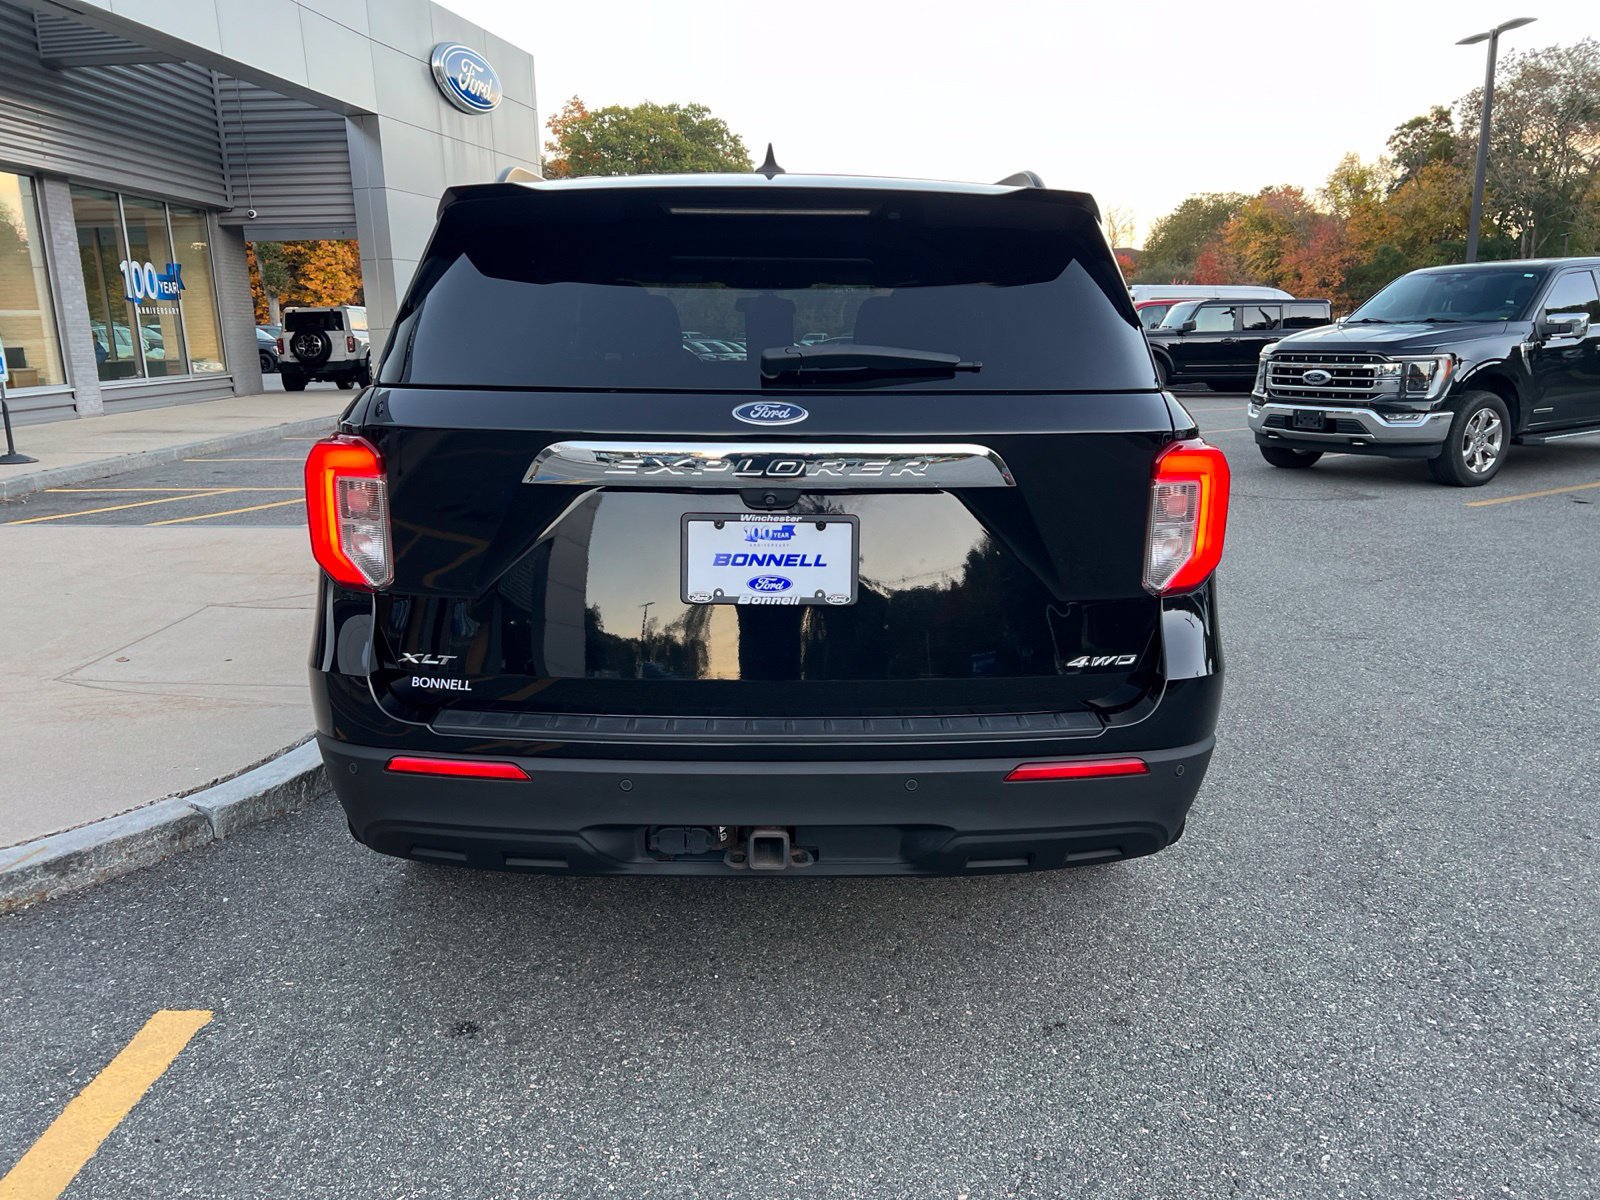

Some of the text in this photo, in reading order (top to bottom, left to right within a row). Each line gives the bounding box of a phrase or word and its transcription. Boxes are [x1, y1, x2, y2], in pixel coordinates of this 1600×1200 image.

[458, 58, 493, 101] Ford
[119, 260, 159, 300] 100
[137, 306, 179, 315] ANNIVERSARY
[749, 404, 791, 419] Ford
[603, 457, 930, 476] EXPLORER
[740, 514, 802, 522] Winchester
[743, 525, 773, 542] 100
[713, 553, 827, 567] BONNELL
[754, 577, 785, 590] Ford
[737, 594, 801, 605] Bonnell
[398, 652, 458, 665] XLT
[1066, 654, 1138, 668] 4WD
[411, 676, 472, 691] BONNELL
